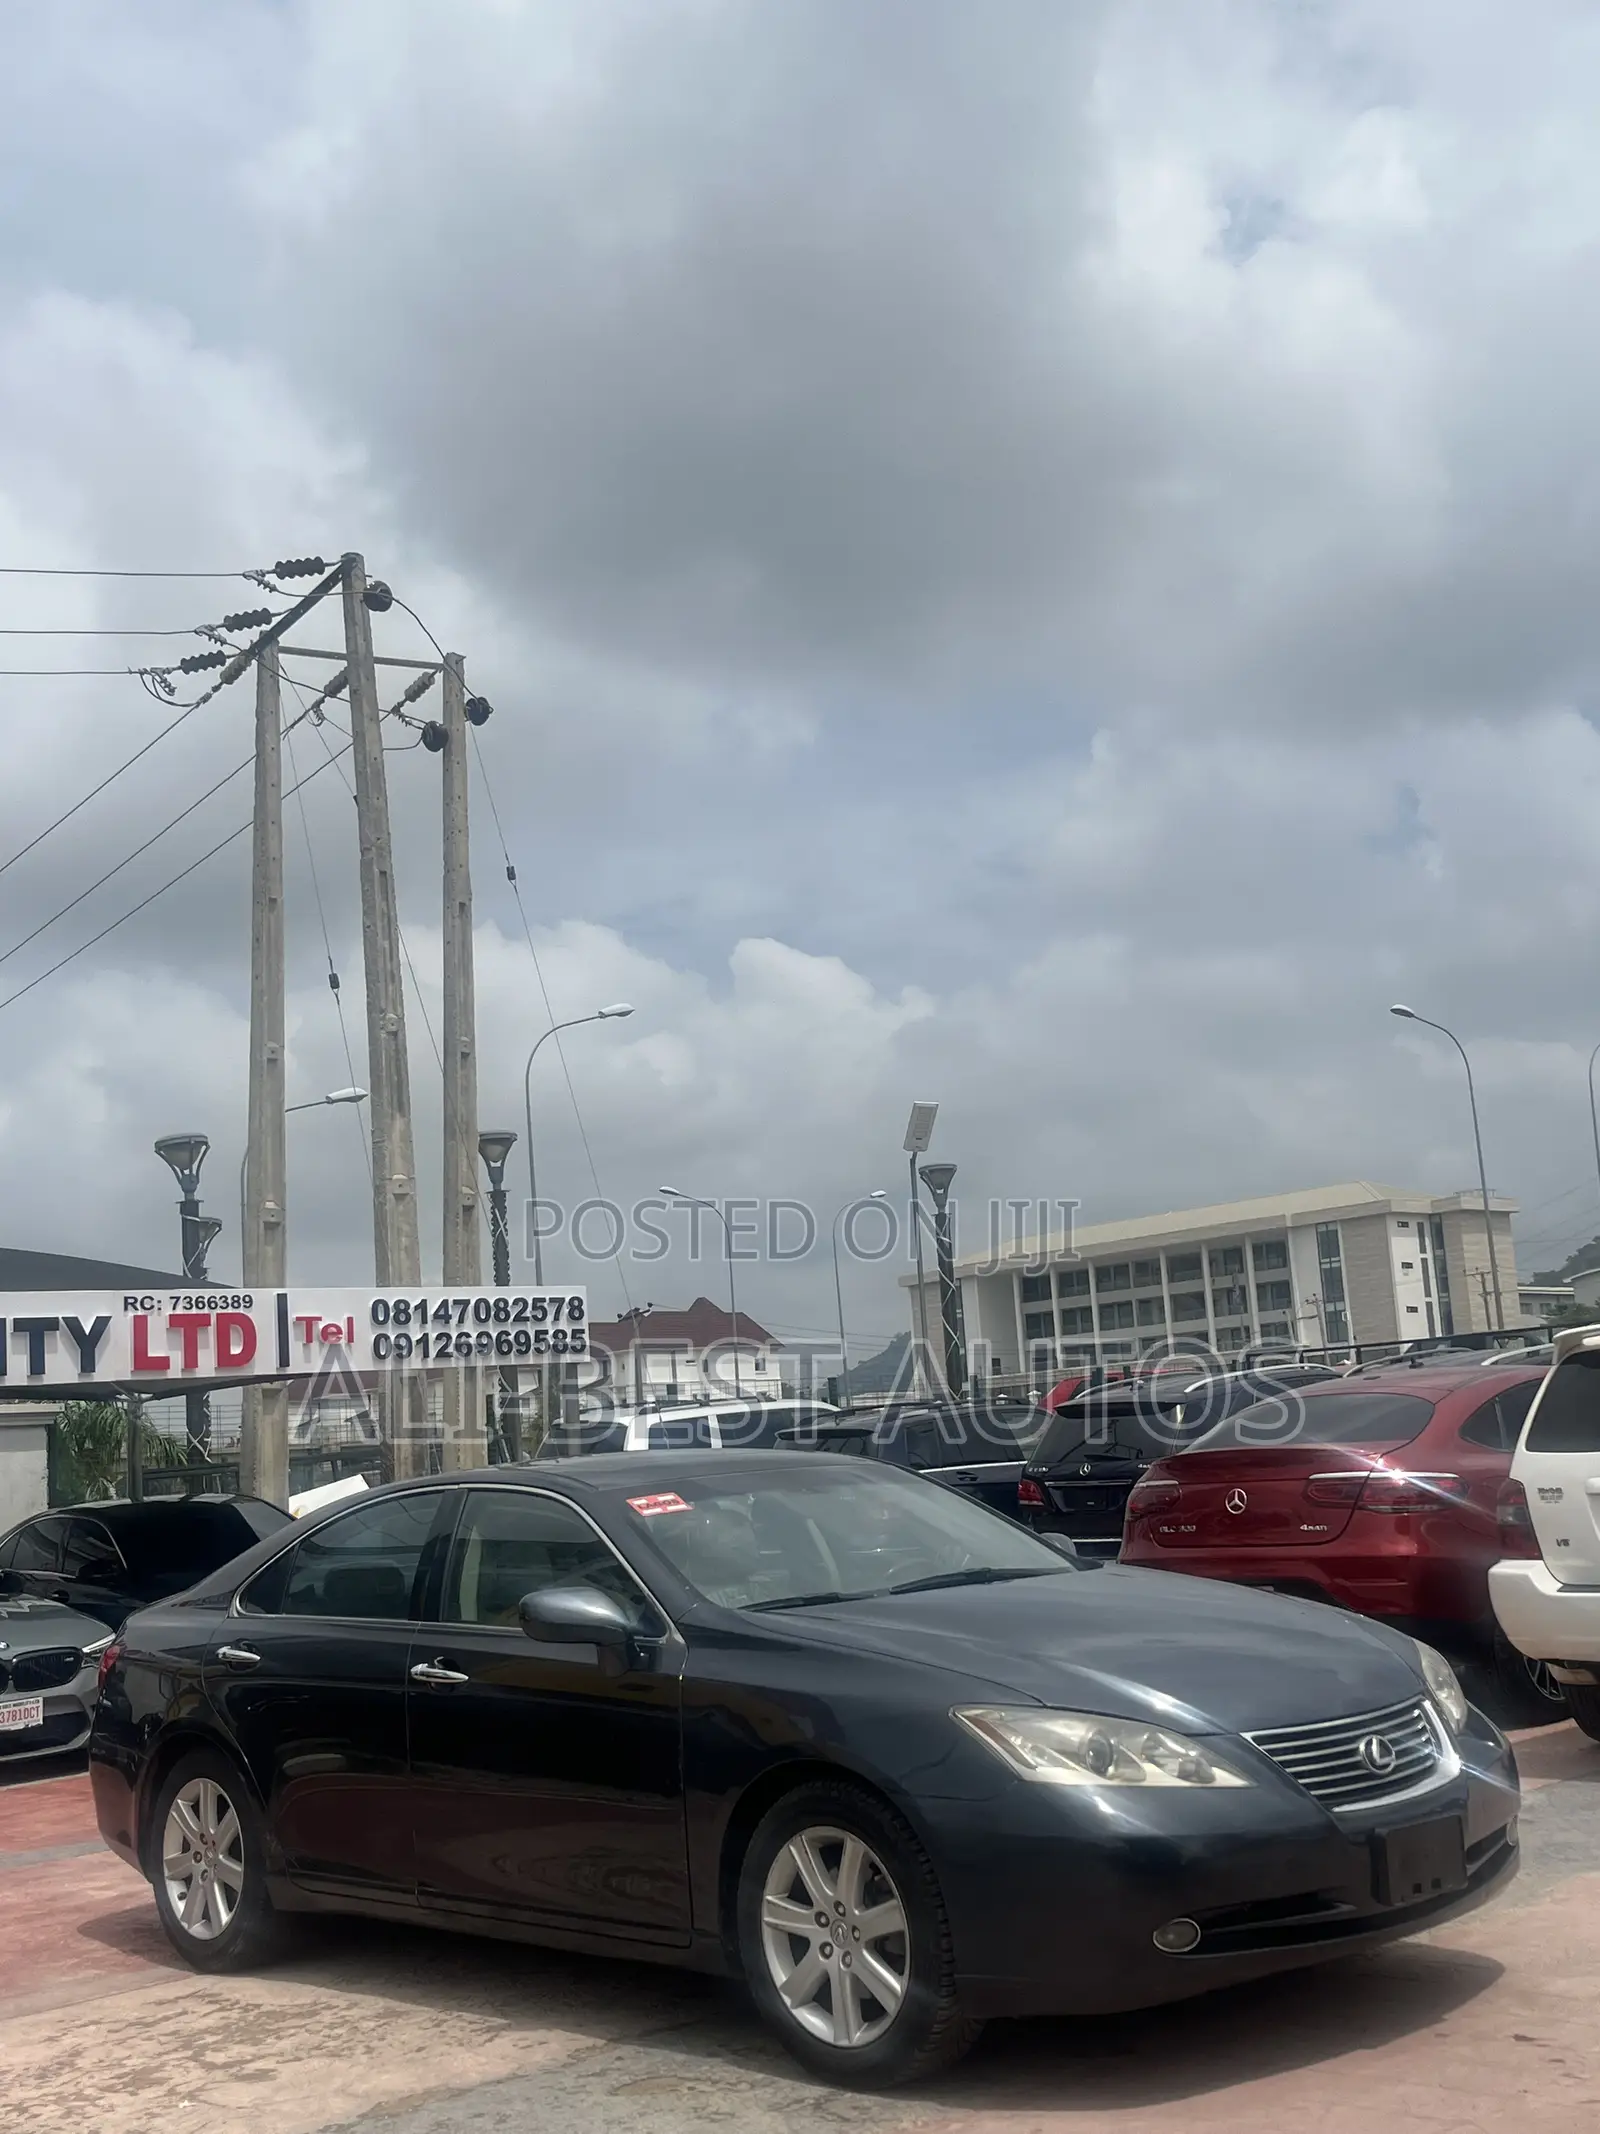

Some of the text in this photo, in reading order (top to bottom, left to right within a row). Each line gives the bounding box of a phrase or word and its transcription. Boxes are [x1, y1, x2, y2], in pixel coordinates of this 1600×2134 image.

[123, 1294, 254, 1312] RC: 7366389
[371, 1296, 585, 1326] 08147082578
[133, 1312, 258, 1371] LTD
[294, 1315, 355, 1345] Tel
[373, 1328, 587, 1360] 09126969585
